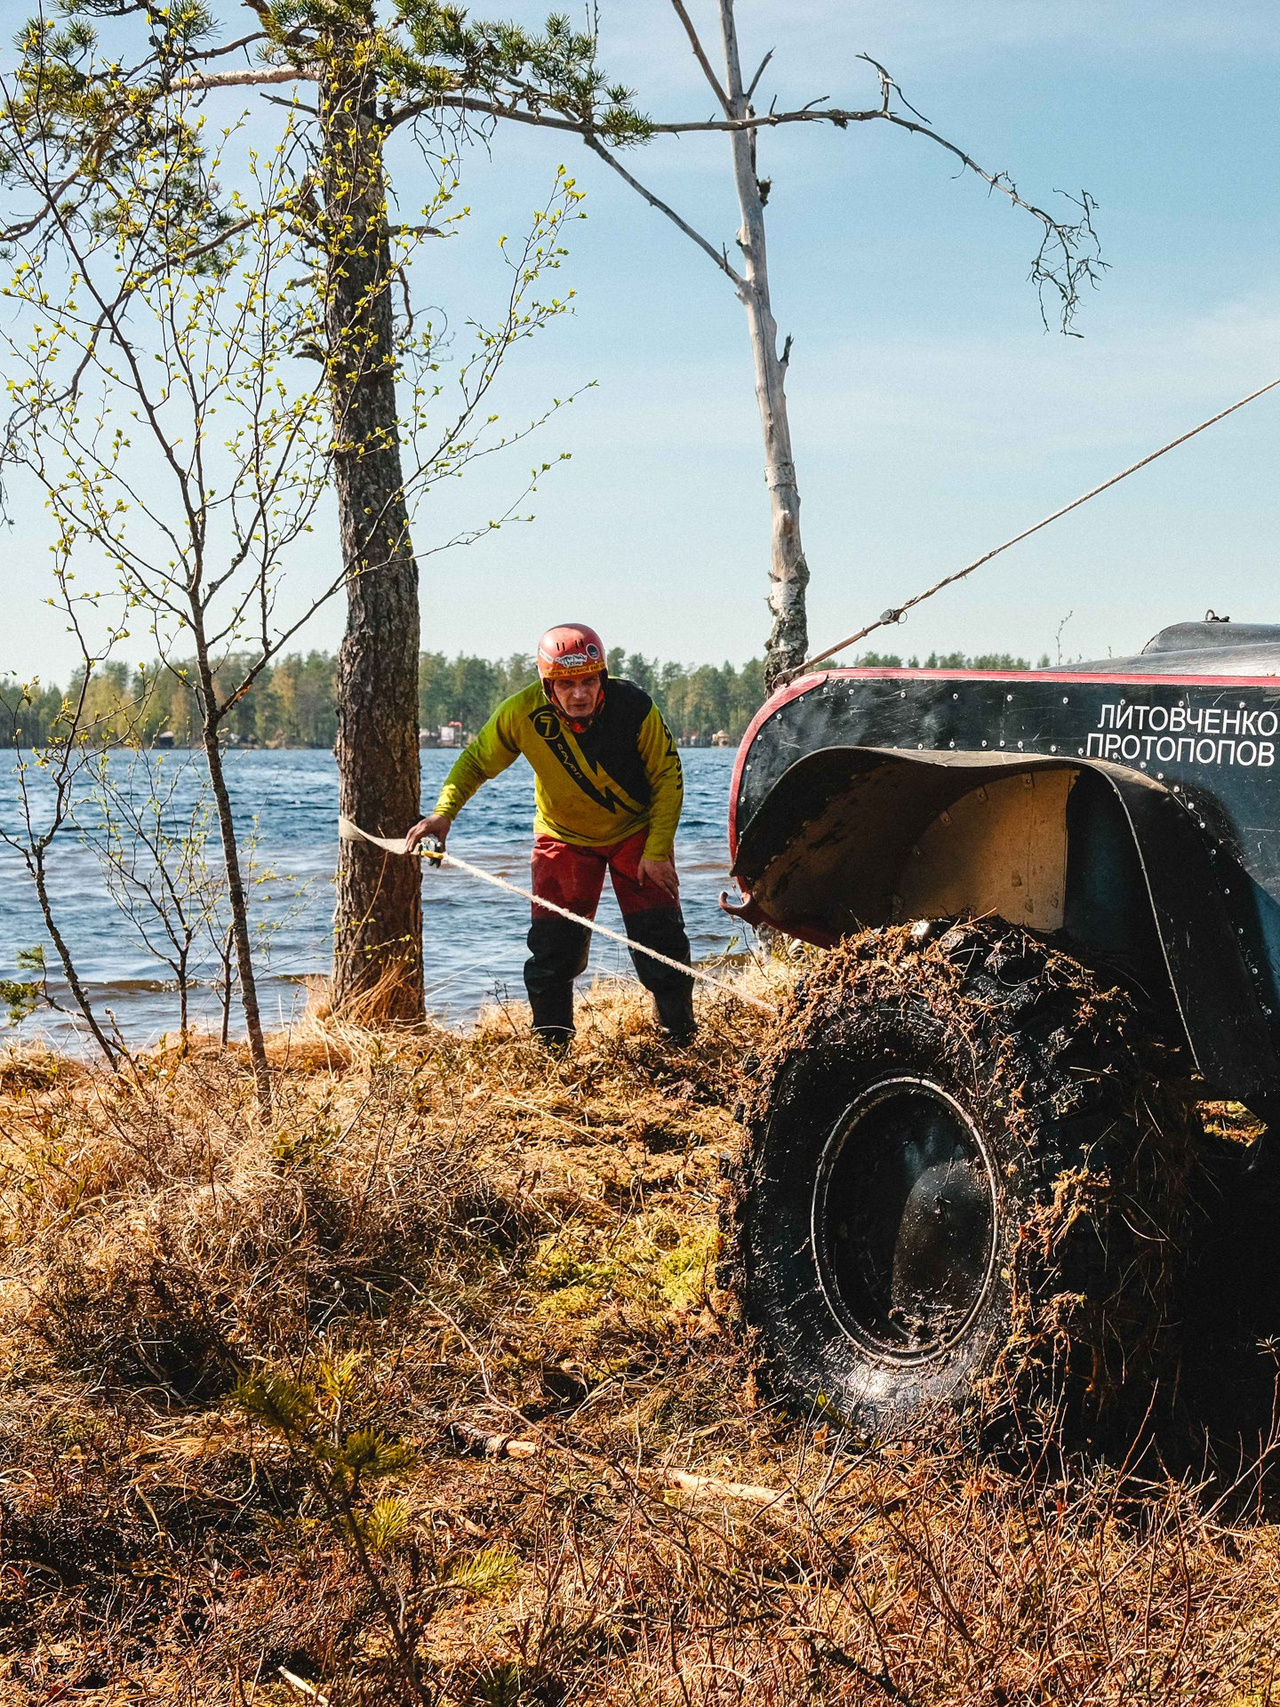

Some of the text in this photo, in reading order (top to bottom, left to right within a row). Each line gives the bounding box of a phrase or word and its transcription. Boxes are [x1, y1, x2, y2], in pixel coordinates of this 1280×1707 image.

[540, 715, 552, 737] 7
[1097, 704, 1279, 737] ЛИТОВЧЕНКО
[1086, 733, 1275, 767] ПРОТОПОПОВ
